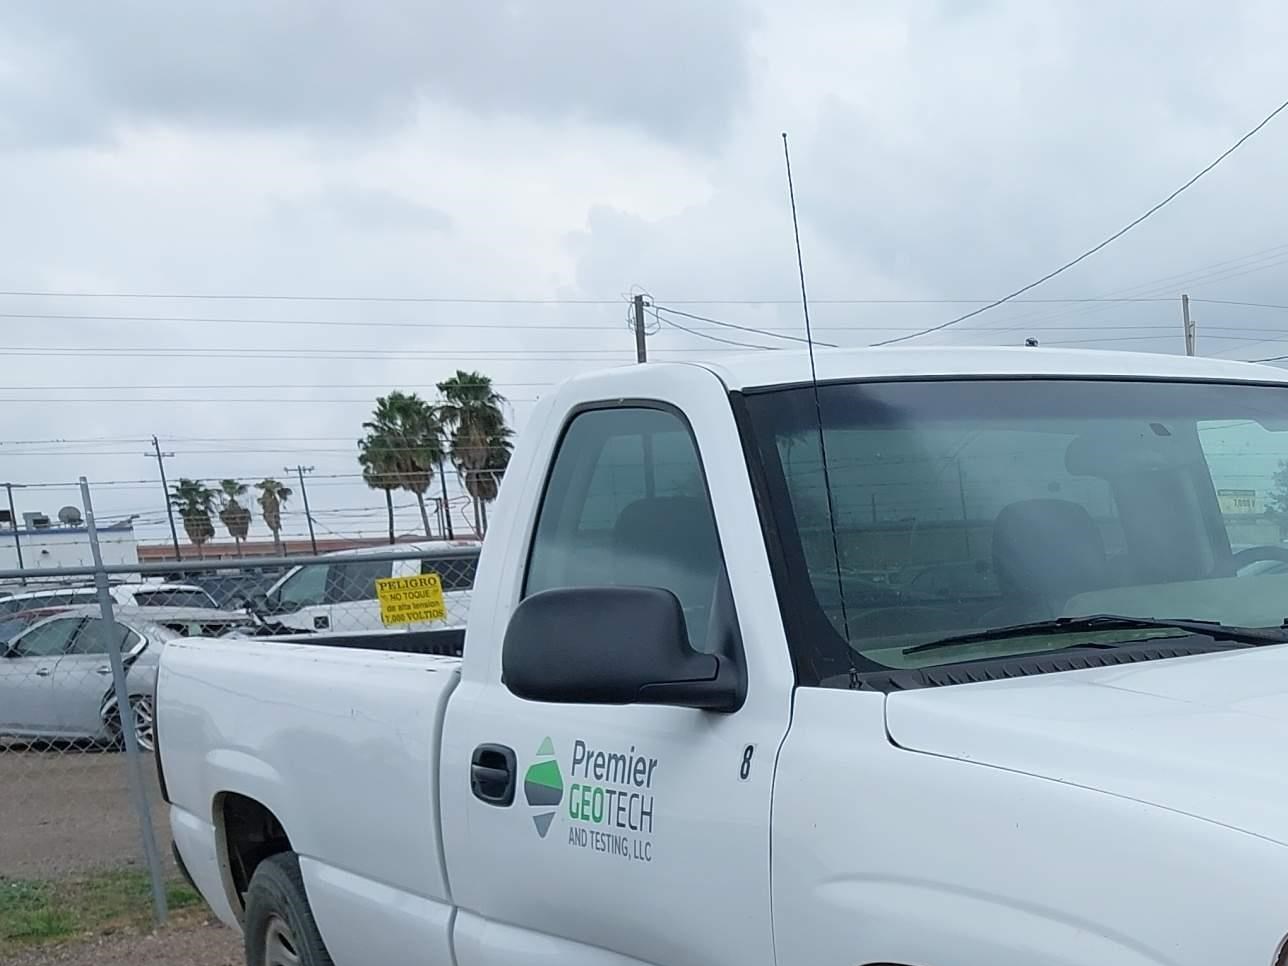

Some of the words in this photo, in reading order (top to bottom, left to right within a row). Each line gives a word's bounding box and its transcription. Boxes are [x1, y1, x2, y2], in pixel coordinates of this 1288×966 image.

[379, 577, 437, 590] PELIGRO
[390, 593, 402, 601] NO
[402, 590, 431, 600] TOQUE
[571, 739, 658, 788] Premier
[740, 744, 754, 779] 8
[568, 783, 654, 833] GEOTECH
[568, 827, 588, 848] AND
[589, 830, 631, 860] TESTING,
[633, 839, 653, 862] LLC
